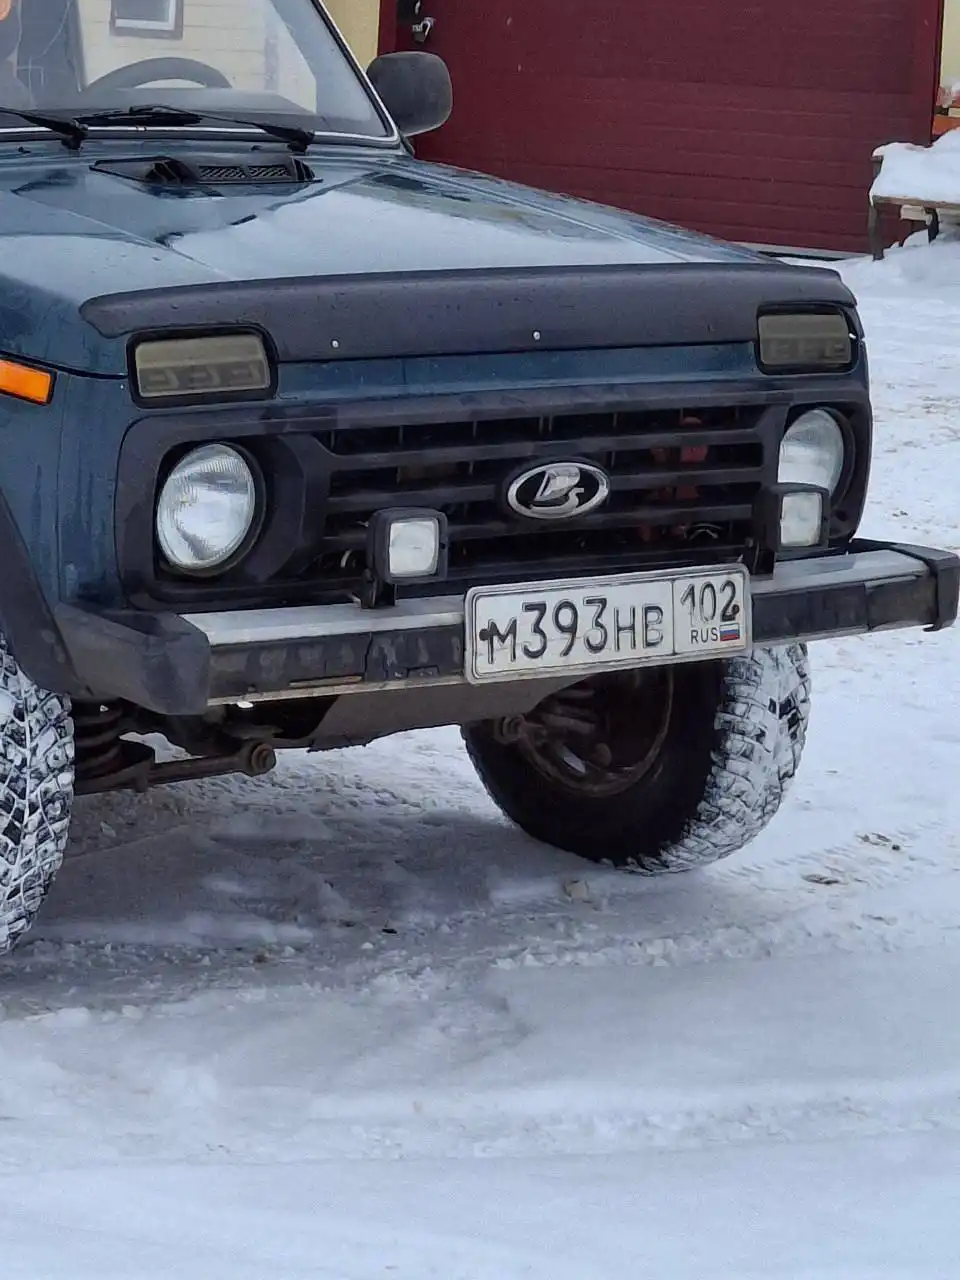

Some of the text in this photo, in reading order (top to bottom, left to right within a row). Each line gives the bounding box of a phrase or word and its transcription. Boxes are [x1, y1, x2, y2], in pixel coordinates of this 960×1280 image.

[486, 579, 739, 665] М393НВ 102
[690, 627, 719, 645] RUS
